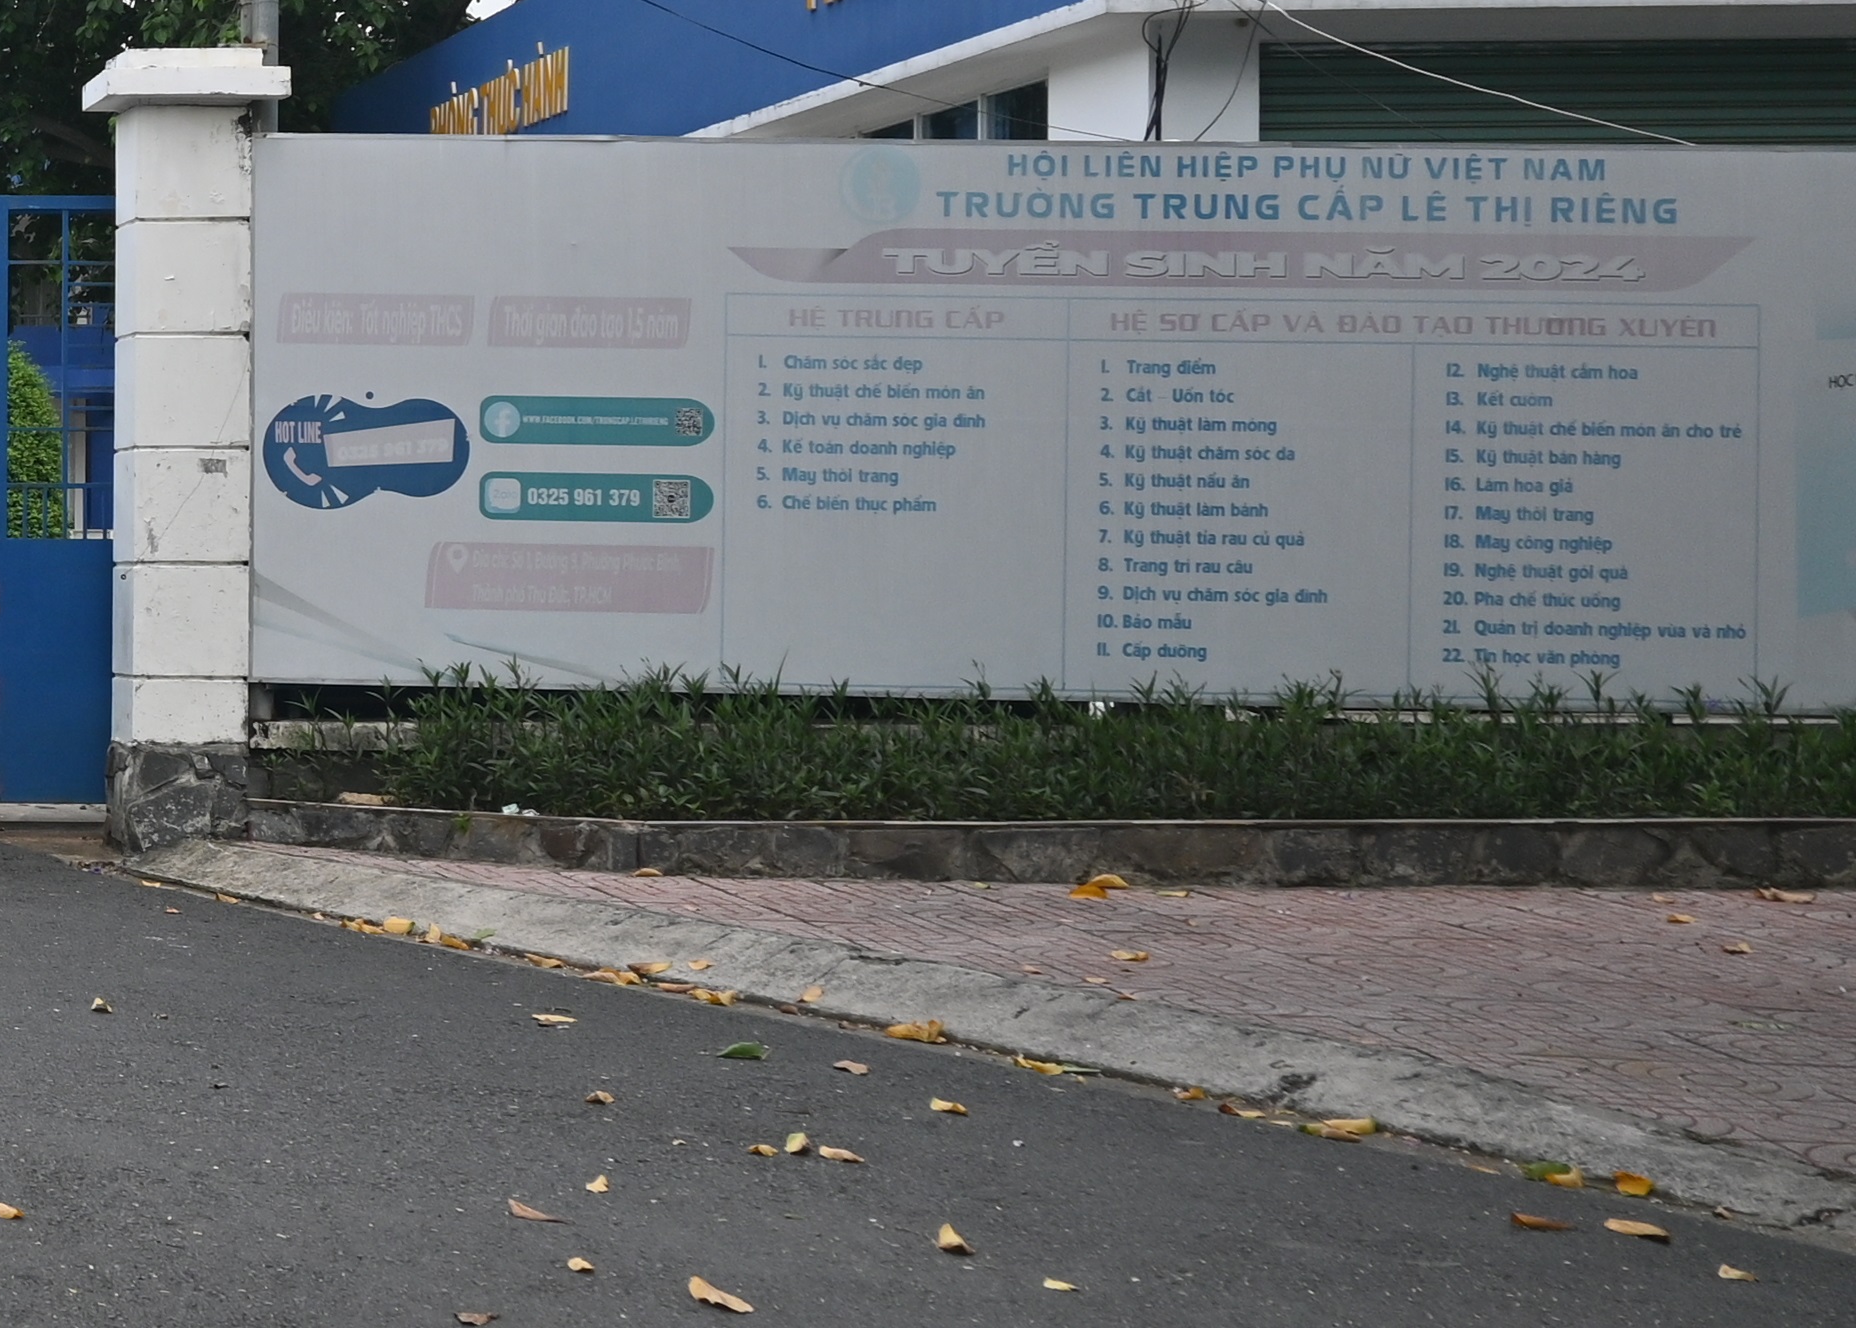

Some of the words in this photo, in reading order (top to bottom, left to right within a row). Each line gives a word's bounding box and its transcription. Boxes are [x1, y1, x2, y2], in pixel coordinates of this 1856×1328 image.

[523, 42, 569, 127] HÀNH
[1007, 150, 1068, 182] HỘI
[1085, 151, 1162, 178] LIÊN
[1178, 152, 1258, 182] HIỆP
[1274, 155, 1346, 182] PHỤ
[1362, 153, 1412, 180] NỮ
[1425, 154, 1508, 184] VIỆT
[1524, 158, 1606, 181] NAM
[936, 190, 1115, 219] TRƯỜNG
[1133, 192, 1279, 220] TRUNG
[1298, 183, 1384, 221] CẤP
[1402, 191, 1447, 222] LÊ
[1466, 195, 1532, 226] THỊ
[1551, 192, 1678, 224] RIÊNG
[883, 240, 1109, 278] TUYỂN
[1126, 250, 1287, 279] SINH
[1305, 247, 1466, 280] NĂM
[1480, 255, 1645, 281] 2024
[838, 309, 934, 329] TRUNG
[1127, 360, 1171, 377] Trang
[275, 421, 295, 443] HOT
[298, 421, 322, 443] LINE
[757, 467, 770, 481] 5.
[782, 468, 816, 485] May
[859, 470, 899, 486] trang
[528, 488, 568, 504] 0325
[574, 489, 602, 505] 961
[609, 489, 640, 506] 379
[757, 495, 772, 509] 6.
[1475, 535, 1509, 553] May
